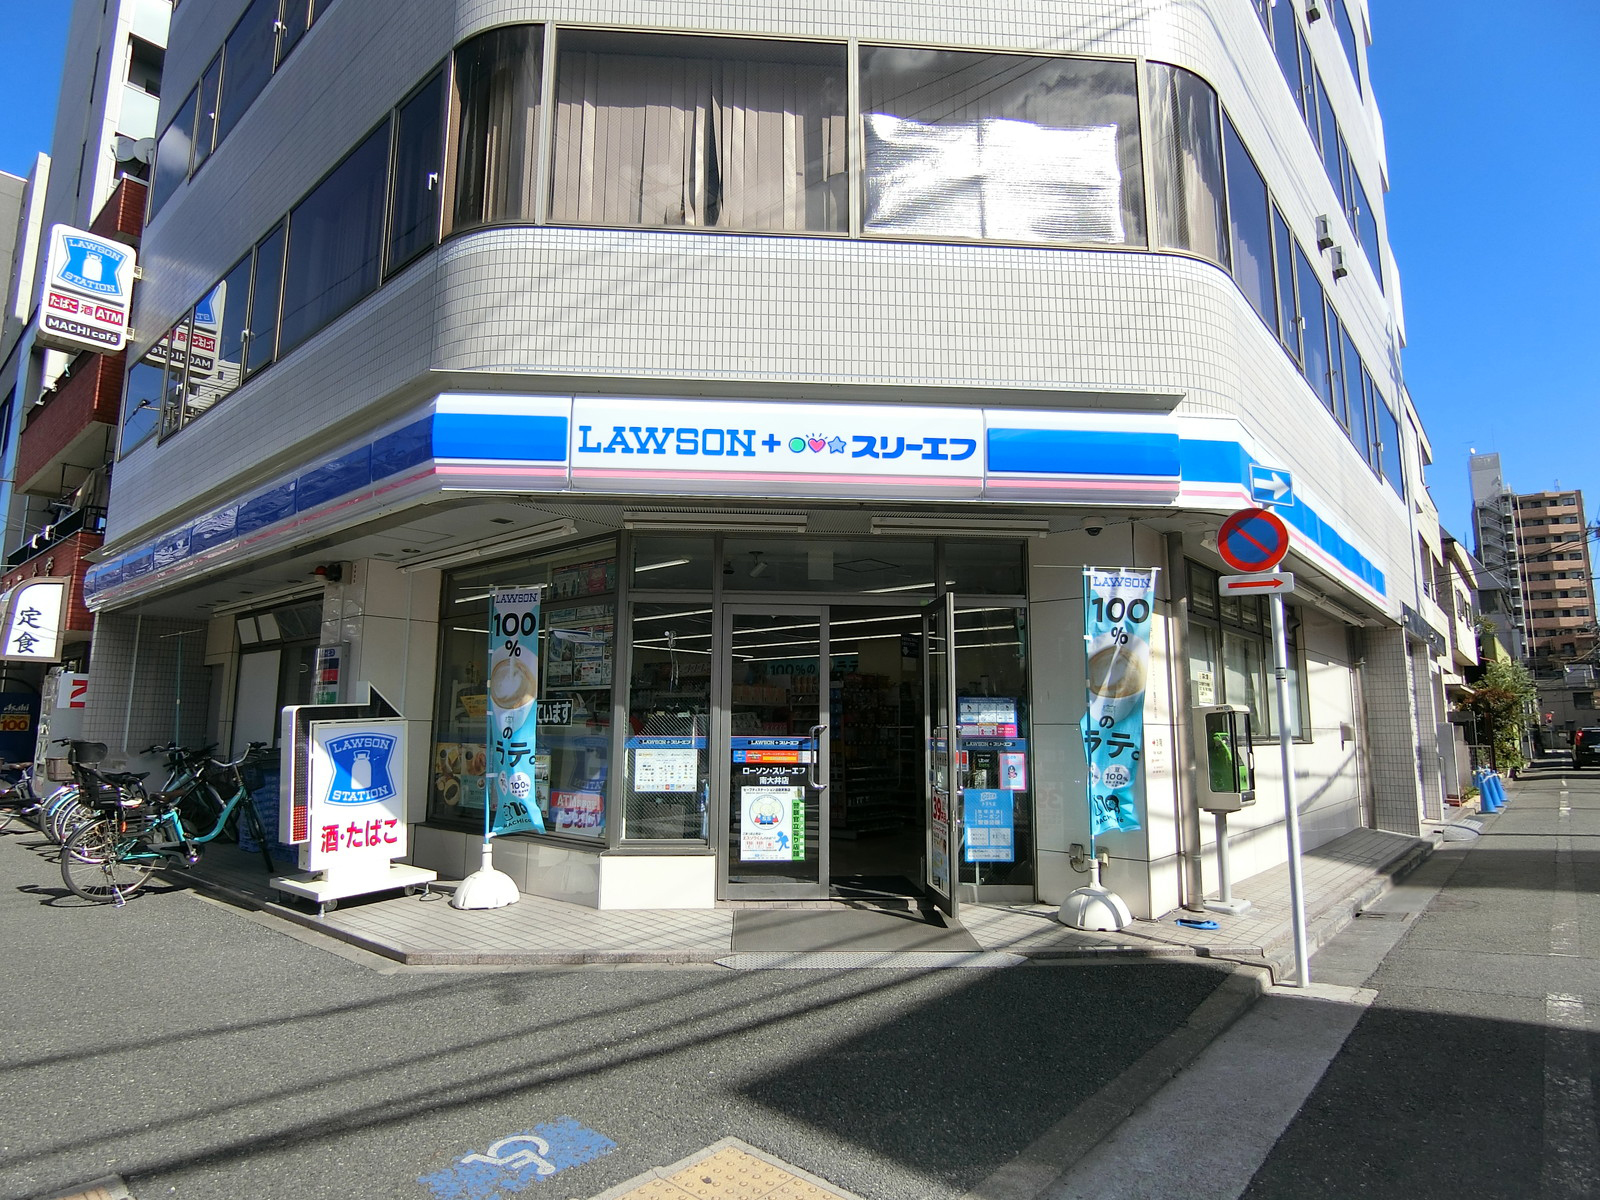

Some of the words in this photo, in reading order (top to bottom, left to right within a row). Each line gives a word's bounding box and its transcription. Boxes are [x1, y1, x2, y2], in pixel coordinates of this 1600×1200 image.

[68, 238, 123, 261] LAWSON
[64, 270, 116, 292] STATION
[49, 294, 79, 313] たばこ
[80, 304, 94, 316] 酒
[96, 307, 123, 324] ATM
[48, 318, 91, 337] MACHI
[91, 331, 118, 343] café
[578, 425, 756, 457] LAWSON
[851, 435, 977, 462] スリーエフ
[1093, 576, 1151, 588] LAWSON
[495, 592, 538, 604] LAWSON
[1091, 597, 1150, 624] 100
[12, 606, 42, 653] 定食
[493, 612, 537, 637] 100
[332, 738, 391, 754] LAWSON
[742, 767, 806, 775] ローソン・スリーエフ
[759, 776, 790, 785] 南大井店
[332, 785, 389, 801] STATION
[321, 818, 398, 853] 酒・たばこ
